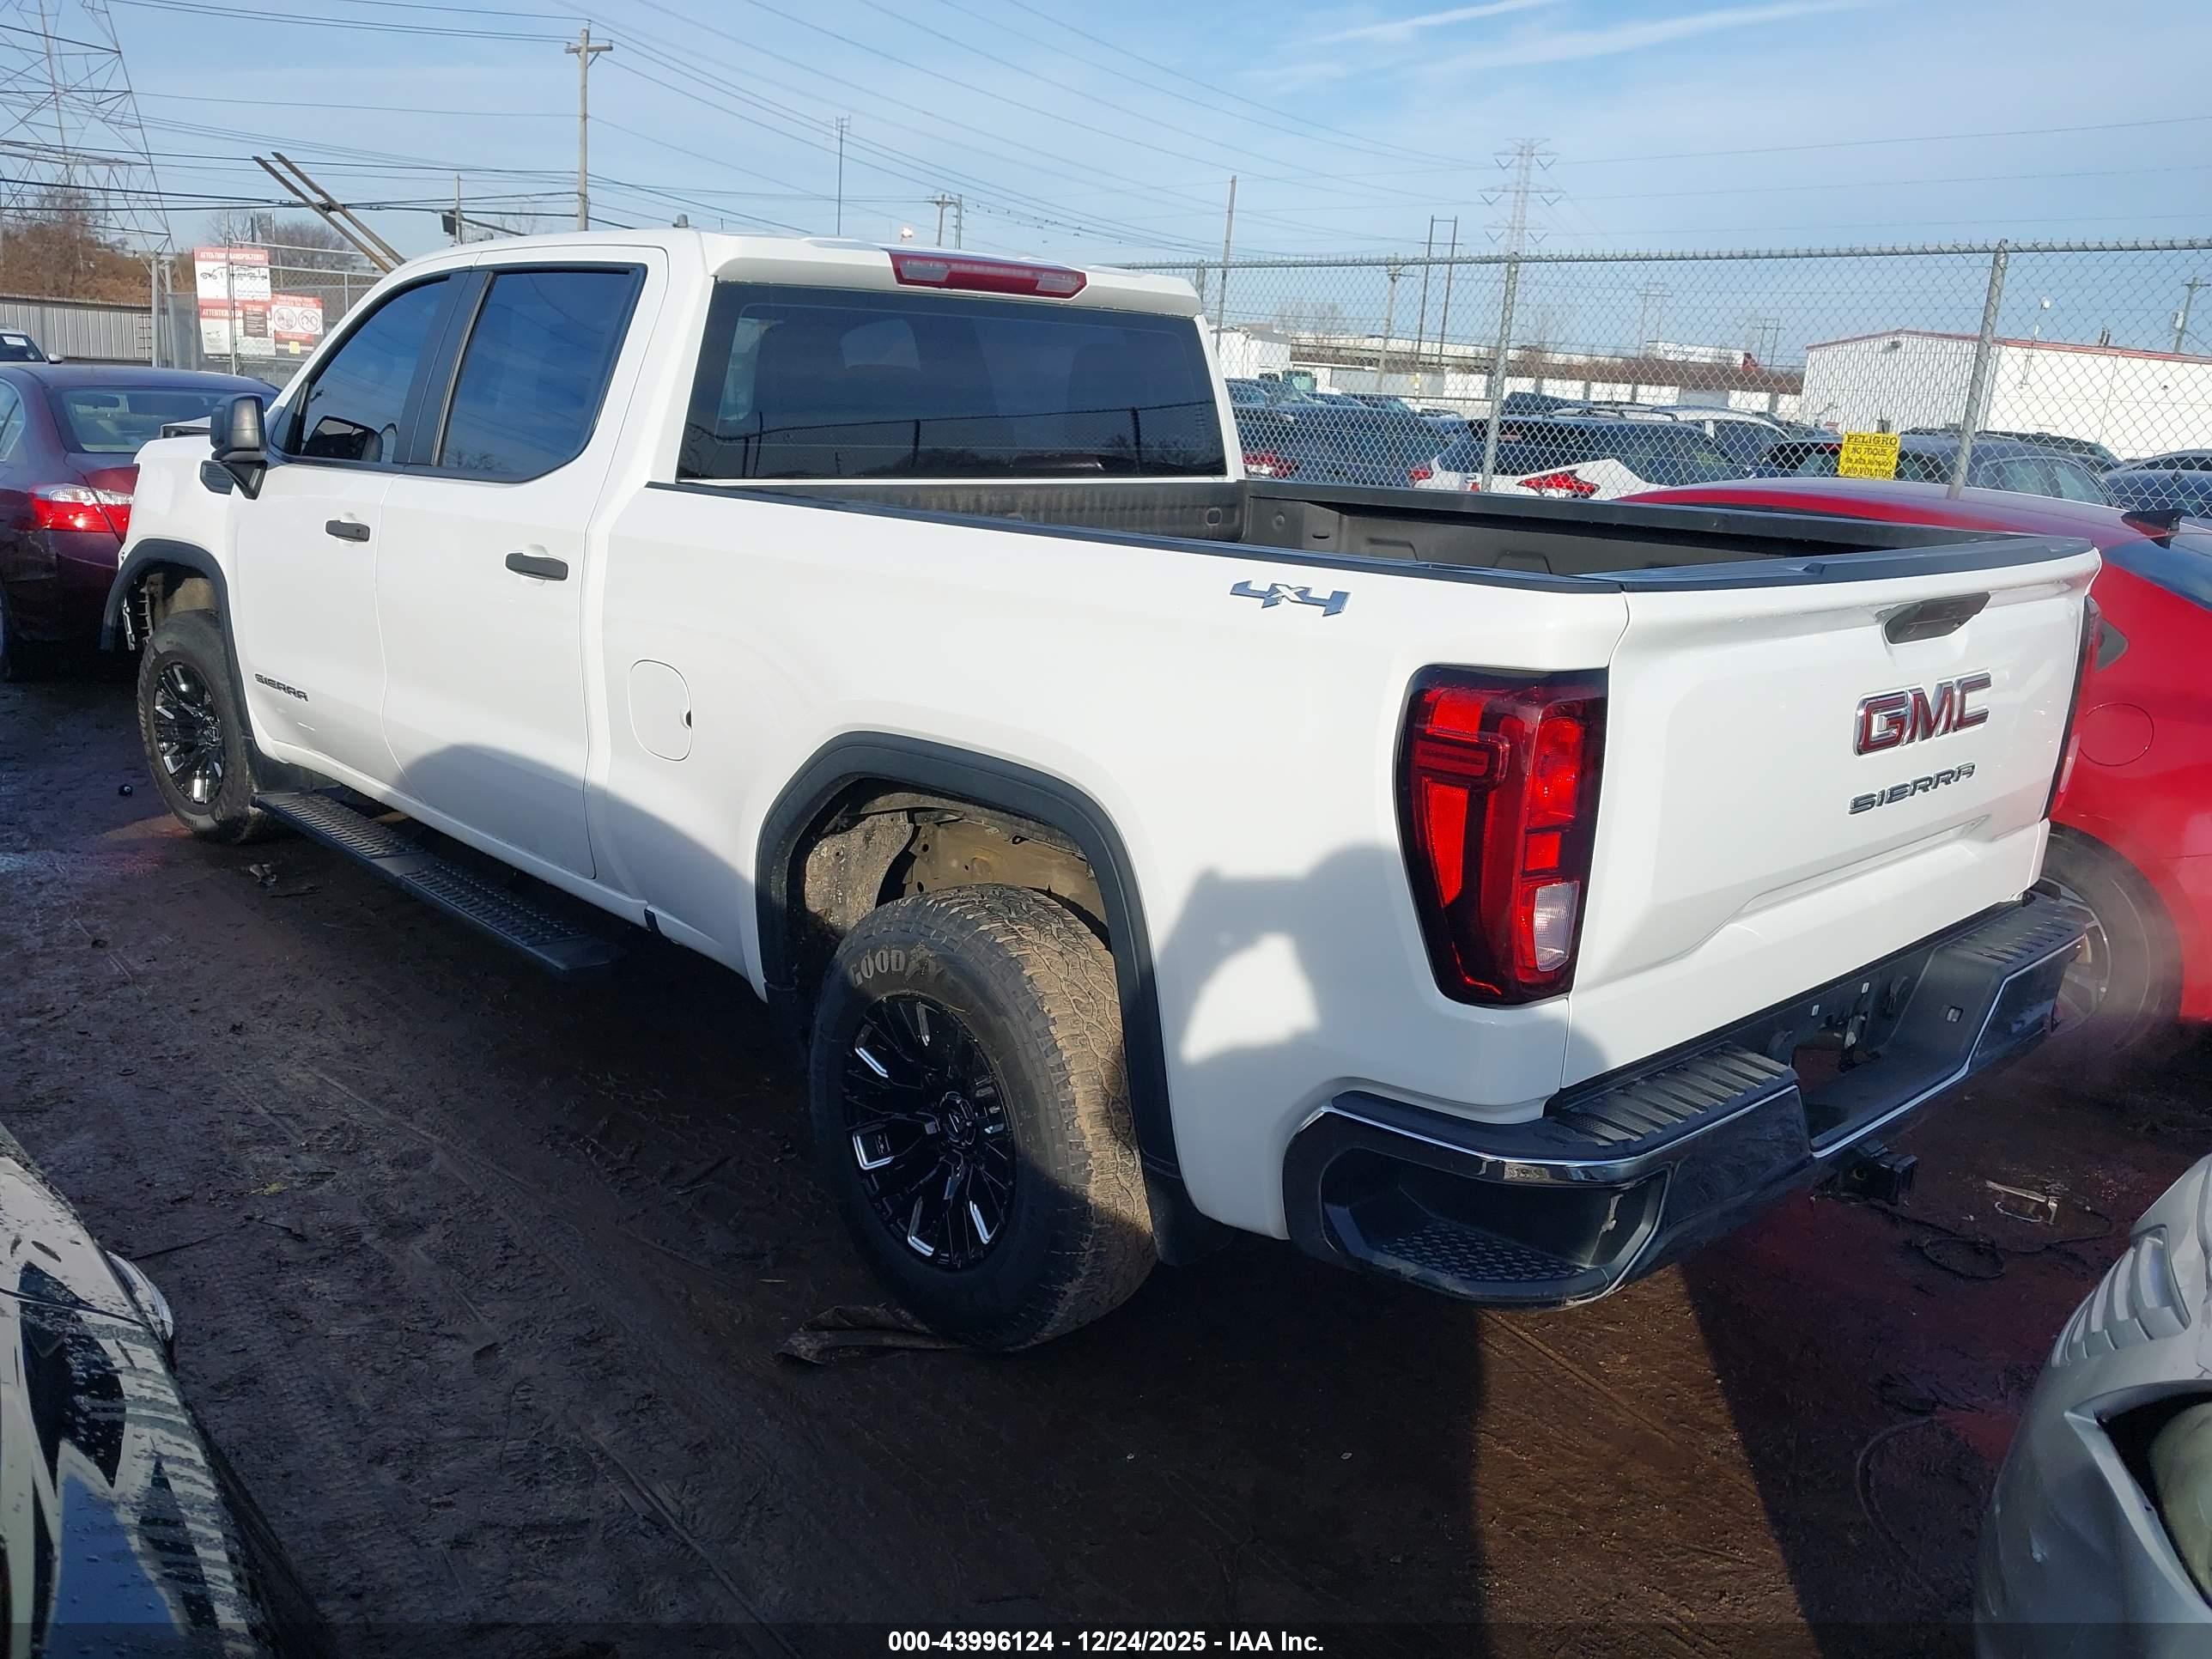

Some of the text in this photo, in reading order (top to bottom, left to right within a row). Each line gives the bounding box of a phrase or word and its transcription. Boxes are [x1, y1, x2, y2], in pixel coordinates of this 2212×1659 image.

[228, 252, 264, 261] RANSPORTERS!
[1847, 434, 1897, 446] PELIGRO
[1851, 447, 1887, 457] NO TOQUE
[255, 673, 308, 702] SIERRA
[1852, 671, 1992, 757] GMC
[1848, 762, 1976, 816] SIERRA
